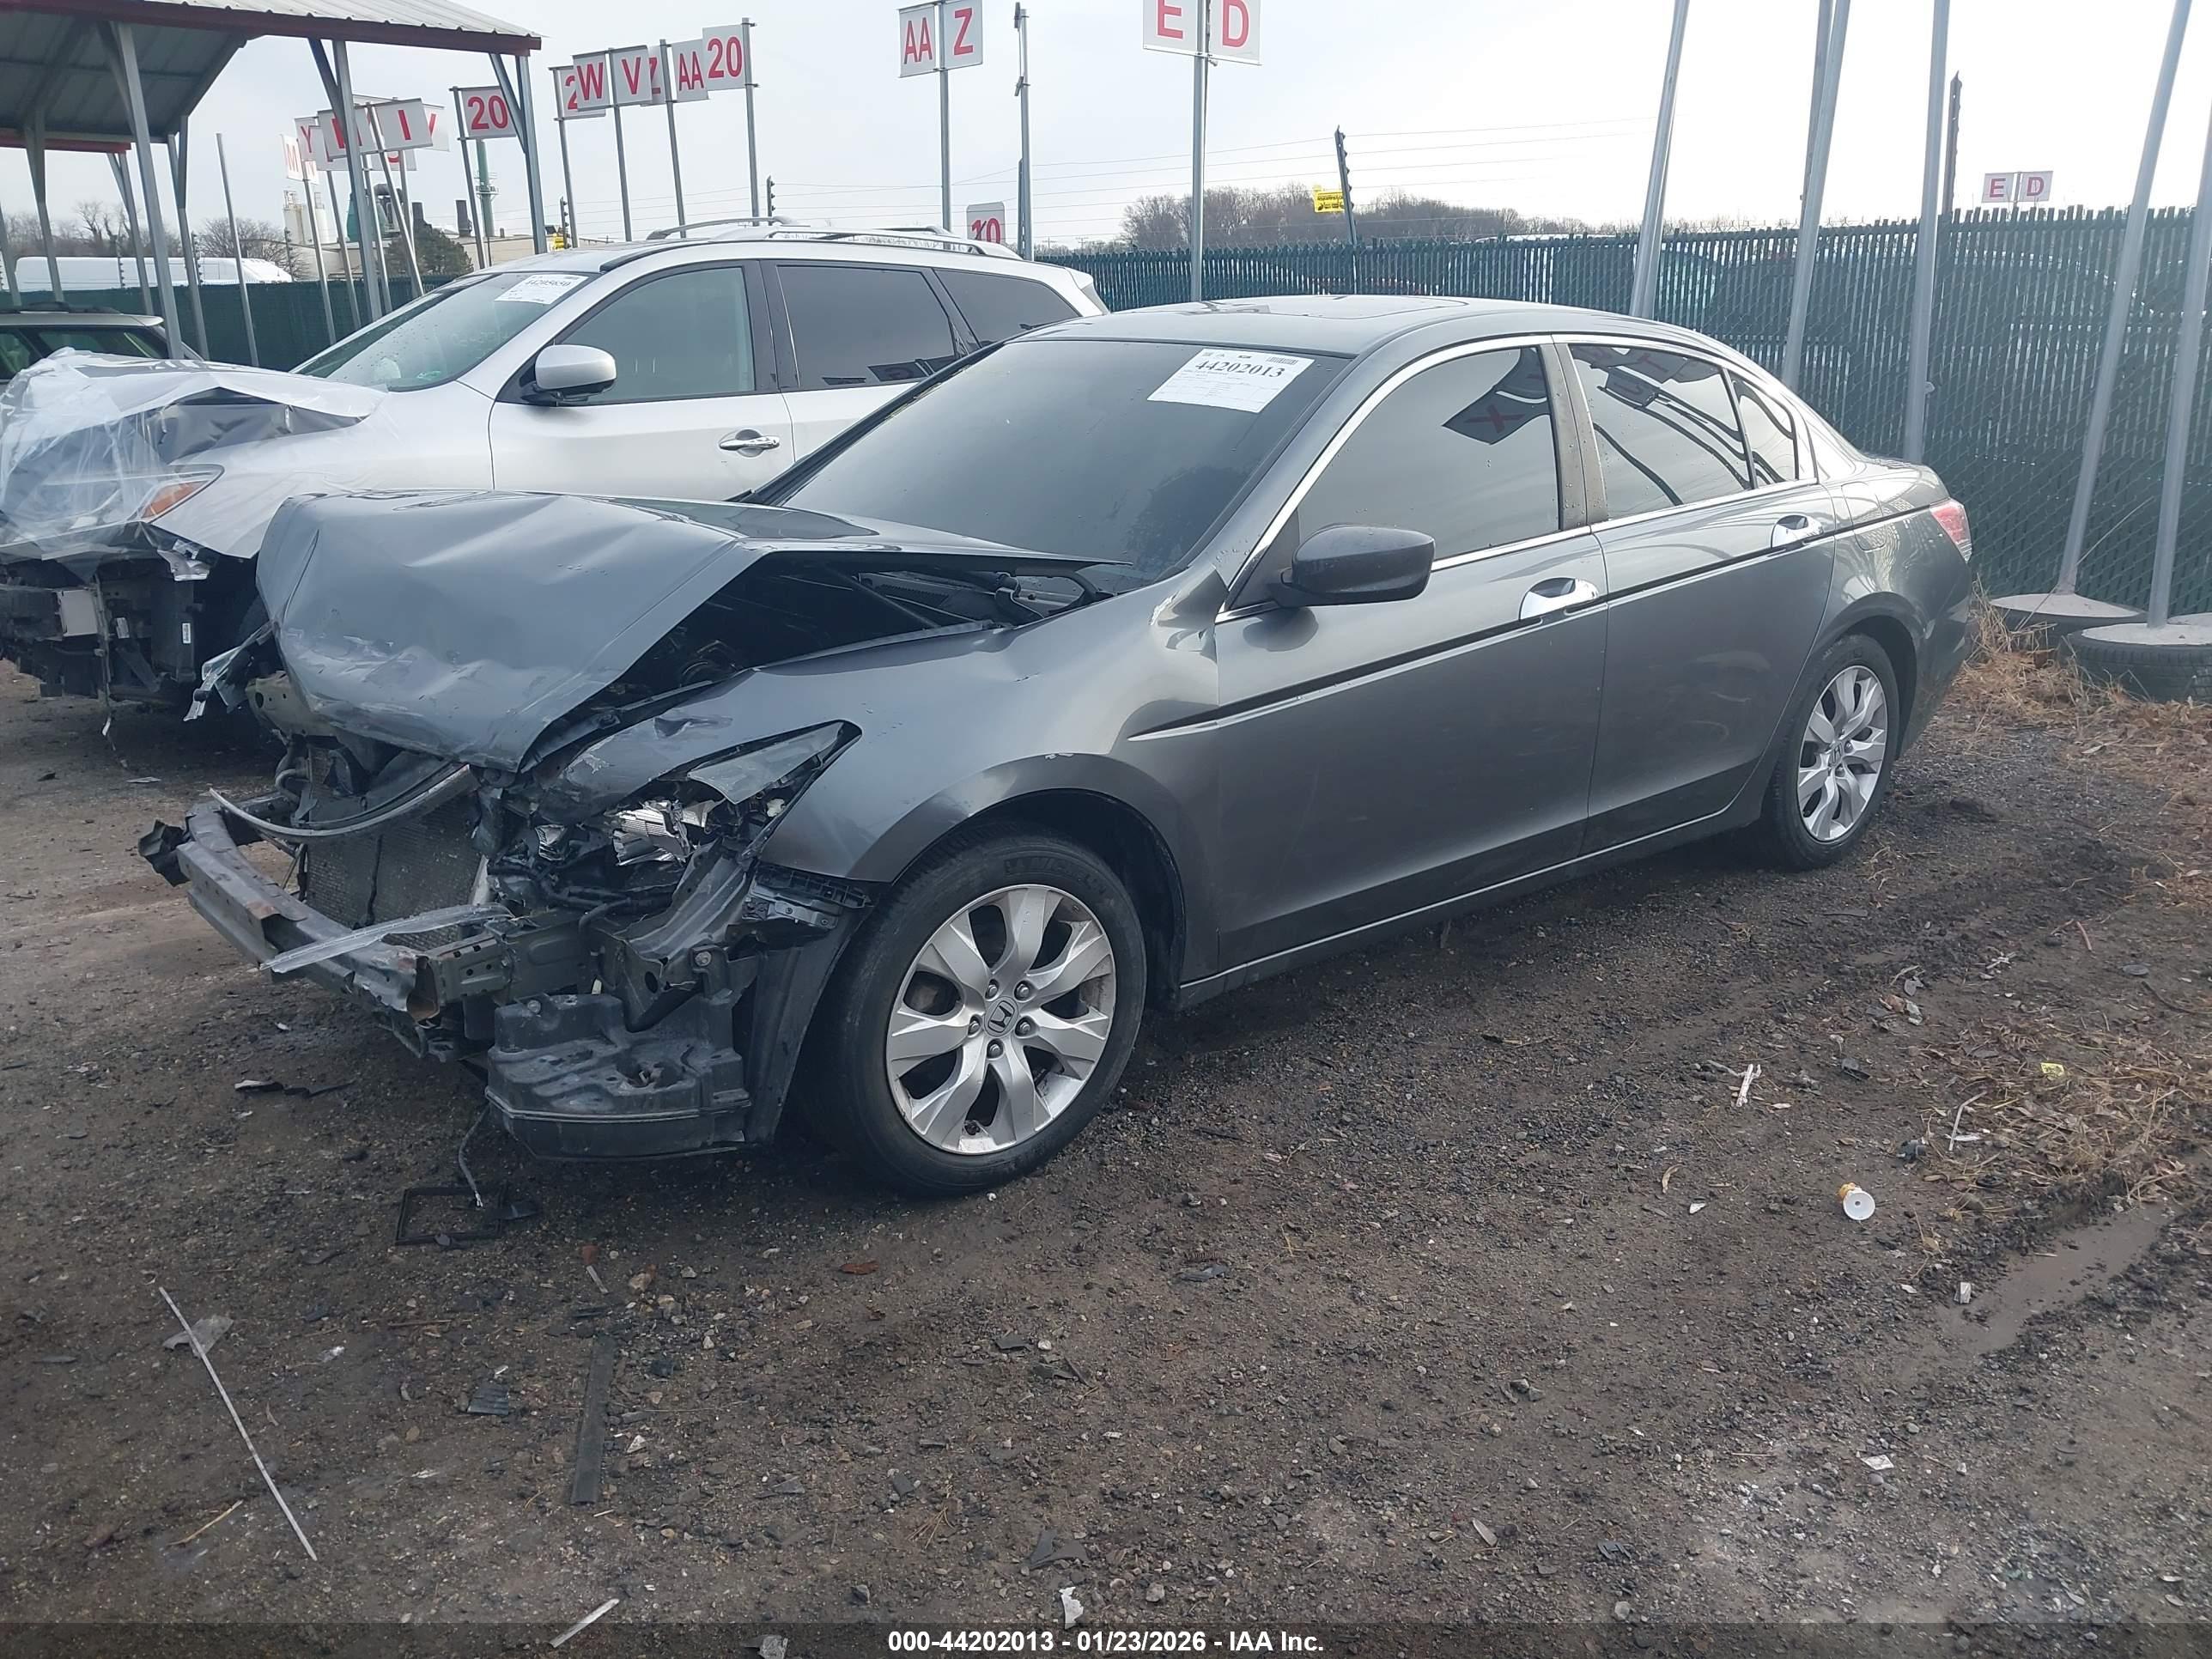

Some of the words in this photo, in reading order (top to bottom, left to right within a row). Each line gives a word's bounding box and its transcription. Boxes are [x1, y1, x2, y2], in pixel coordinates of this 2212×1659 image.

[904, 17, 933, 64] AA
[954, 8, 974, 55] Z
[1158, 0, 1183, 40] E
[1223, 0, 1249, 47] D
[678, 52, 705, 91] AA
[708, 37, 743, 78] 20
[577, 62, 604, 100] W
[621, 57, 641, 94] V
[467, 95, 508, 130] 20
[1989, 178, 2006, 198] E
[2027, 177, 2045, 197] D
[1195, 359, 1285, 379] 44202013
